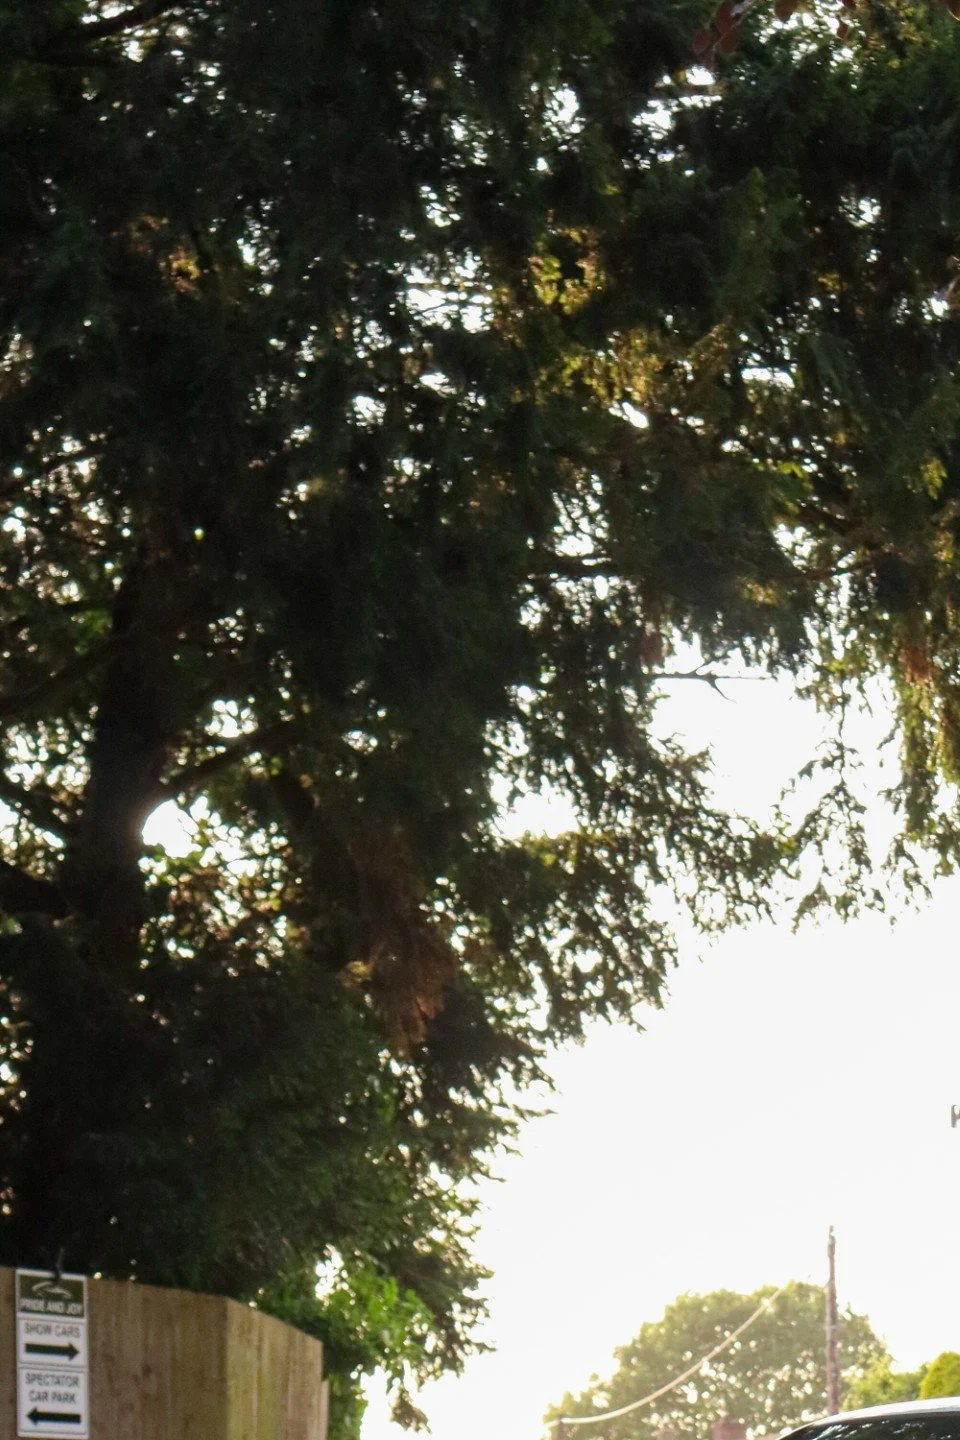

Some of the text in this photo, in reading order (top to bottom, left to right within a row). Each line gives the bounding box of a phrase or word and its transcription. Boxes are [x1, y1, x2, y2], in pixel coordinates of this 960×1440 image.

[46, 1301, 64, 1314] AND
[66, 1303, 82, 1315] JOY
[25, 1322, 81, 1338] SHOW CARS
[25, 1373, 79, 1388] SPECTATOR
[28, 1390, 76, 1404] CAR PARK
